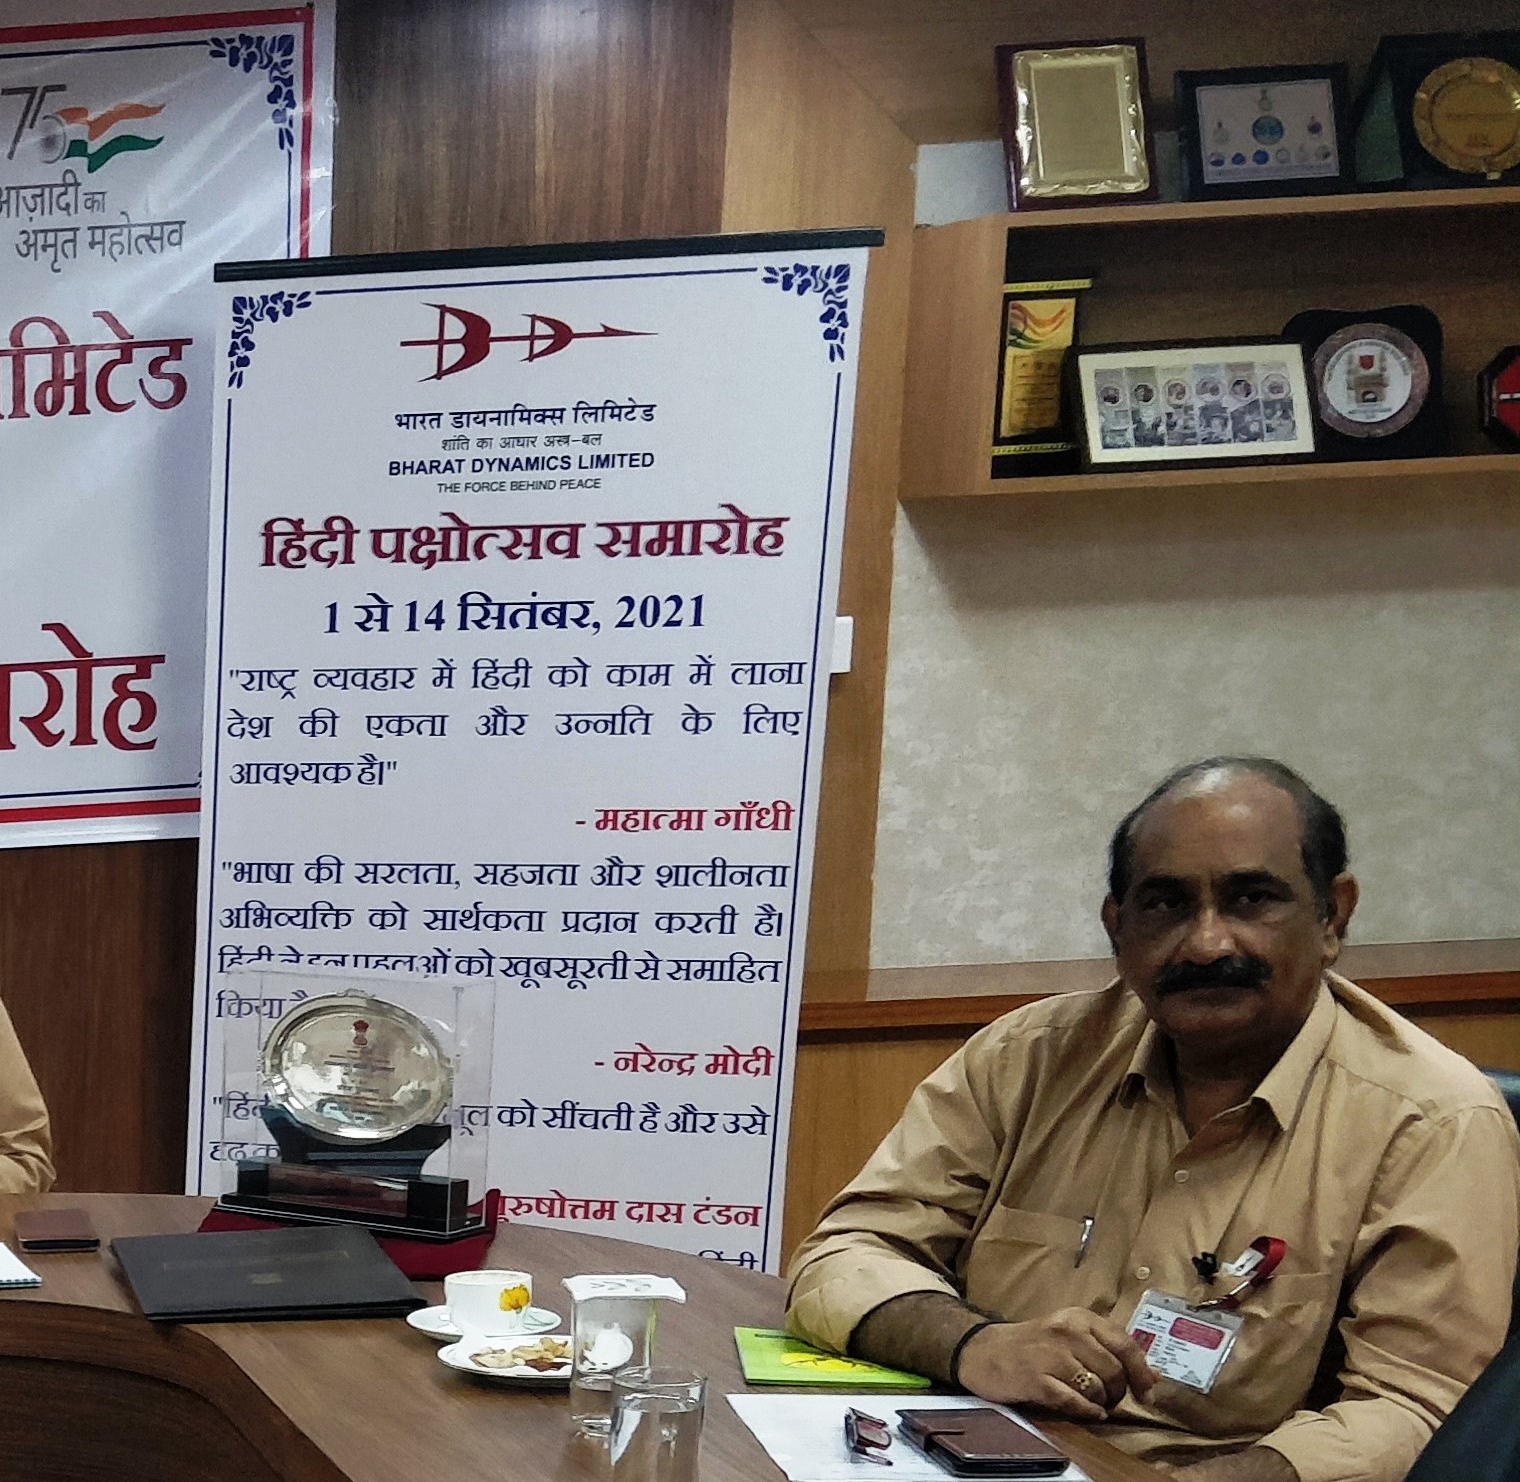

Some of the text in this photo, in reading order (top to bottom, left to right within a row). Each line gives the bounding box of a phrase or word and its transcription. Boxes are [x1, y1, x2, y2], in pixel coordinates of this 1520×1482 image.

[83, 191, 108, 214] का
[15, 211, 187, 273] अमृत महोत्सव
[395, 397, 657, 430] भारत डायनामिक्स लिमिटेड
[476, 438, 493, 450] का
[389, 452, 655, 476] BHARAT DYNAMICS LIMITED
[437, 478, 602, 494] THE FORCE BEHIND PEACE
[259, 503, 791, 571] हिंदी पक्षोत्सव समारोह
[324, 591, 705, 635] 1 से 14 सितंबर, 2021
[313, 666, 418, 691] व्यवहार
[431, 658, 457, 690] में
[472, 657, 532, 690] हिंदी
[548, 657, 591, 688] को
[606, 663, 675, 687] काम
[689, 655, 716, 686] में
[731, 662, 807, 686] लाना
[227, 703, 804, 739] देश की एकता और उन्नति के लिए
[229, 761, 354, 787] आवश्यक
[594, 800, 795, 832] महात्मा गाँधी
[304, 855, 345, 885] की
[354, 862, 460, 890] सरलता,
[474, 863, 580, 887] सहजता
[590, 856, 645, 886] और
[655, 857, 791, 888] शालीनता
[219, 900, 355, 931] अभिव्यक्ति
[368, 901, 409, 931] को
[423, 901, 547, 932] सार्थकता
[560, 911, 639, 934] प्रदान
[655, 904, 739, 935] करती
[455, 948, 497, 978] को
[499, 950, 631, 989] खूबसूरती
[634, 950, 663, 981] से
[665, 952, 783, 983] समाहित
[614, 1042, 775, 1078] नरेन्द्र मोदी
[497, 1099, 538, 1128] को
[542, 1100, 635, 1131] सींचती
[639, 1101, 661, 1133] है
[664, 1103, 719, 1134] और
[723, 1105, 771, 1136] उसे
[626, 1200, 686, 1225] दास
[693, 1196, 763, 1227] टंडन
